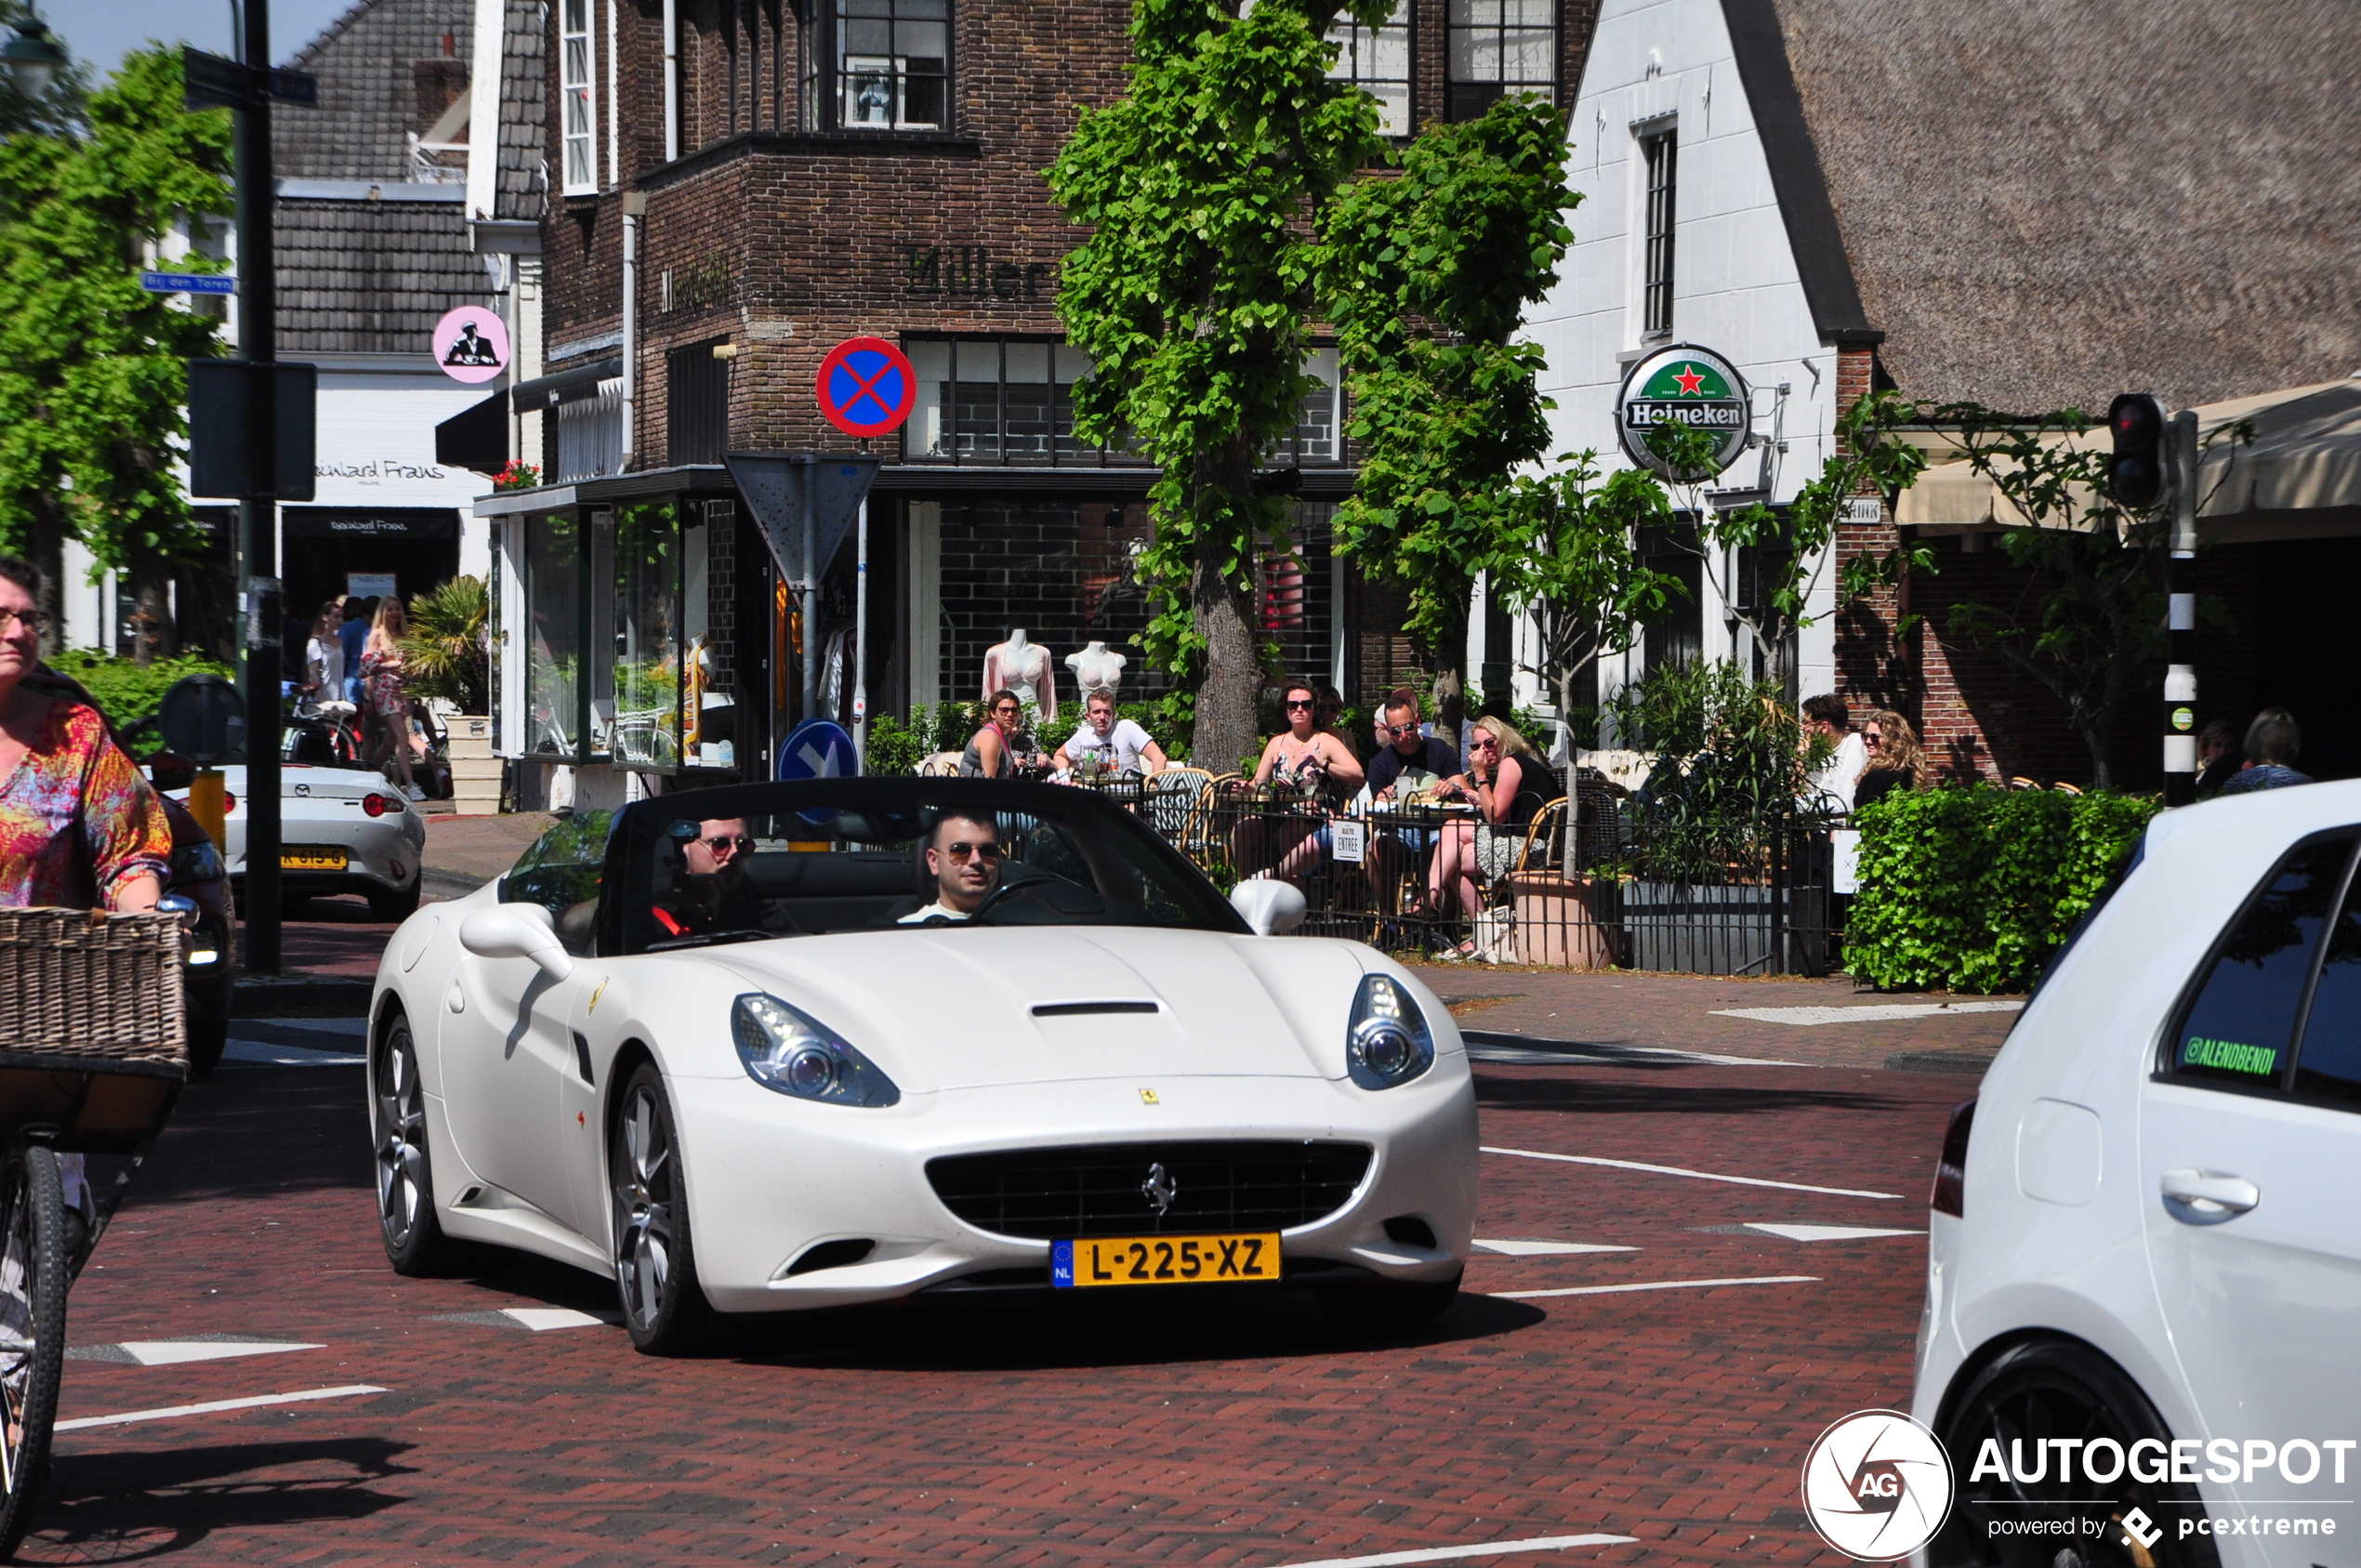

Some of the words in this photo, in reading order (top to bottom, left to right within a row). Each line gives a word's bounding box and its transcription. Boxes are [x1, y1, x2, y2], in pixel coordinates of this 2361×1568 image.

[904, 244, 1045, 297] Miller
[148, 276, 165, 288] Bij
[197, 278, 231, 289] Toren
[1631, 403, 1740, 425] Heineken
[314, 459, 379, 479] einhard
[1843, 503, 1880, 519] RINK
[1338, 837, 1358, 852] ENTREE
[282, 850, 342, 864] R-615-G
[1092, 1239, 1263, 1281] L-225-XZ
[1055, 1267, 1071, 1279] NL
